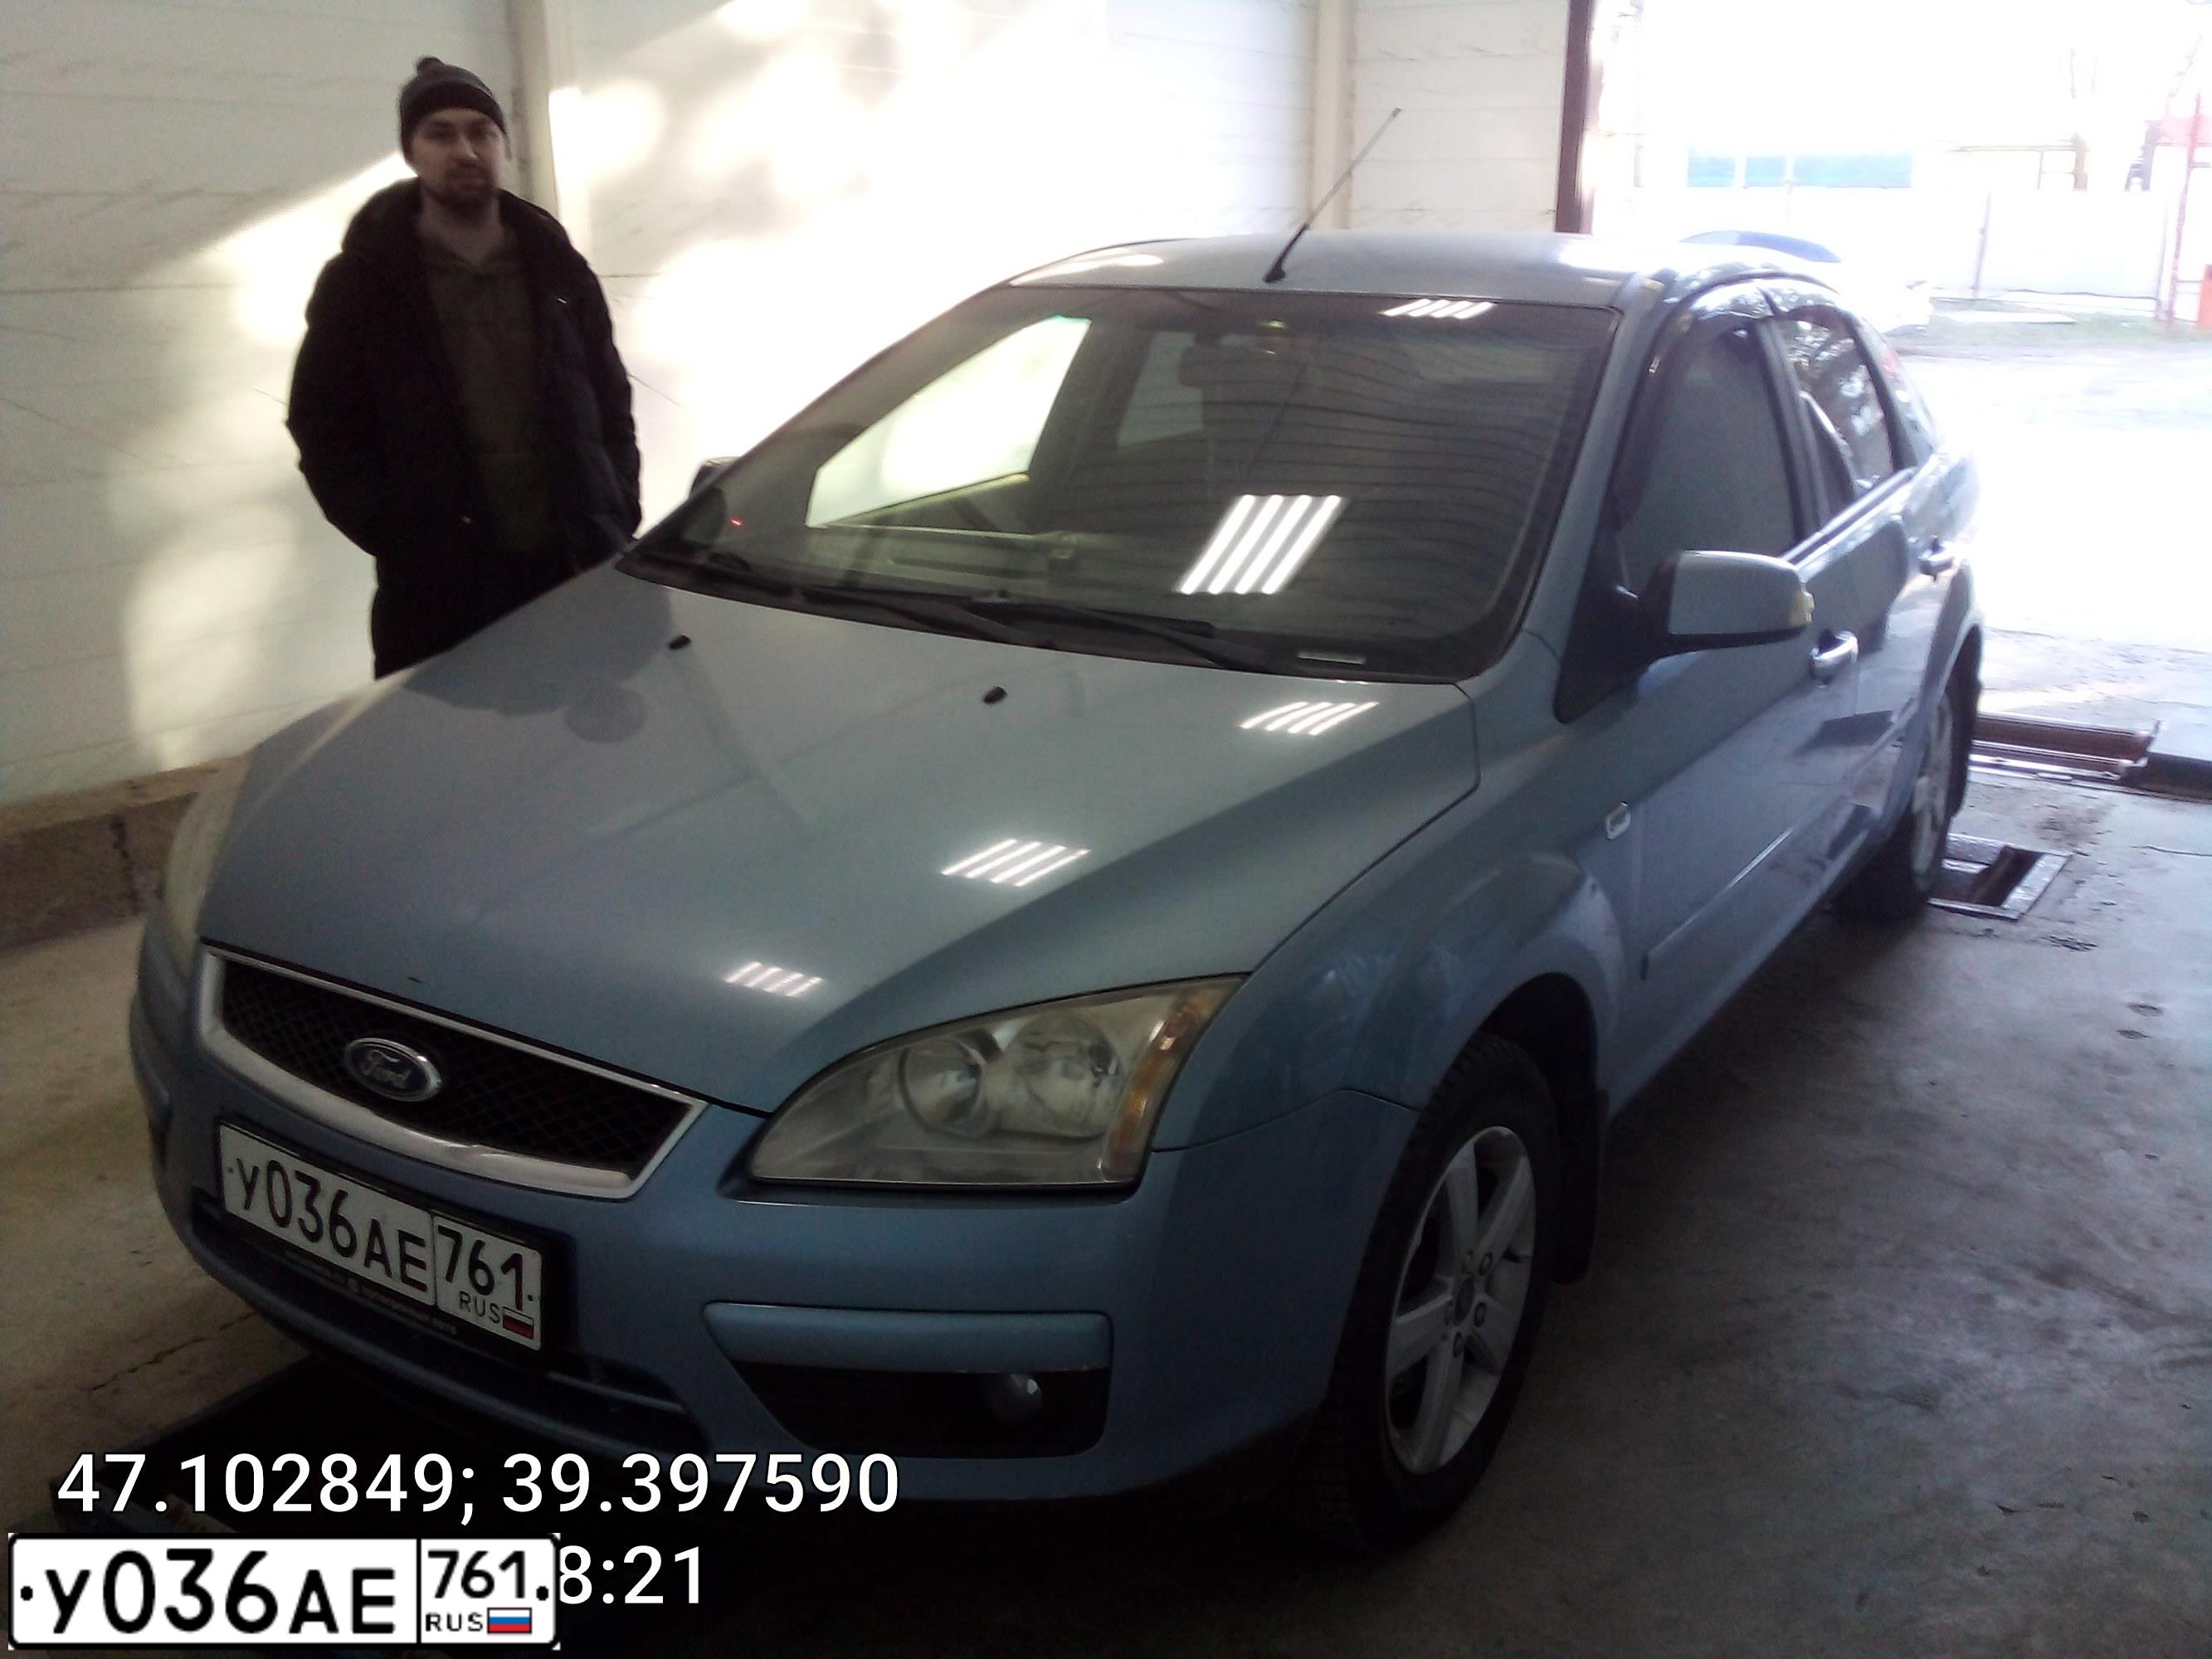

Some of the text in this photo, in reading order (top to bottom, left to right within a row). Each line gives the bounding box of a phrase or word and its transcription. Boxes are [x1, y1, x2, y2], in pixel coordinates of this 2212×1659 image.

[236, 1157, 428, 1293] У036АЕ
[437, 1224, 524, 1311] 761
[458, 1291, 501, 1324] RUS
